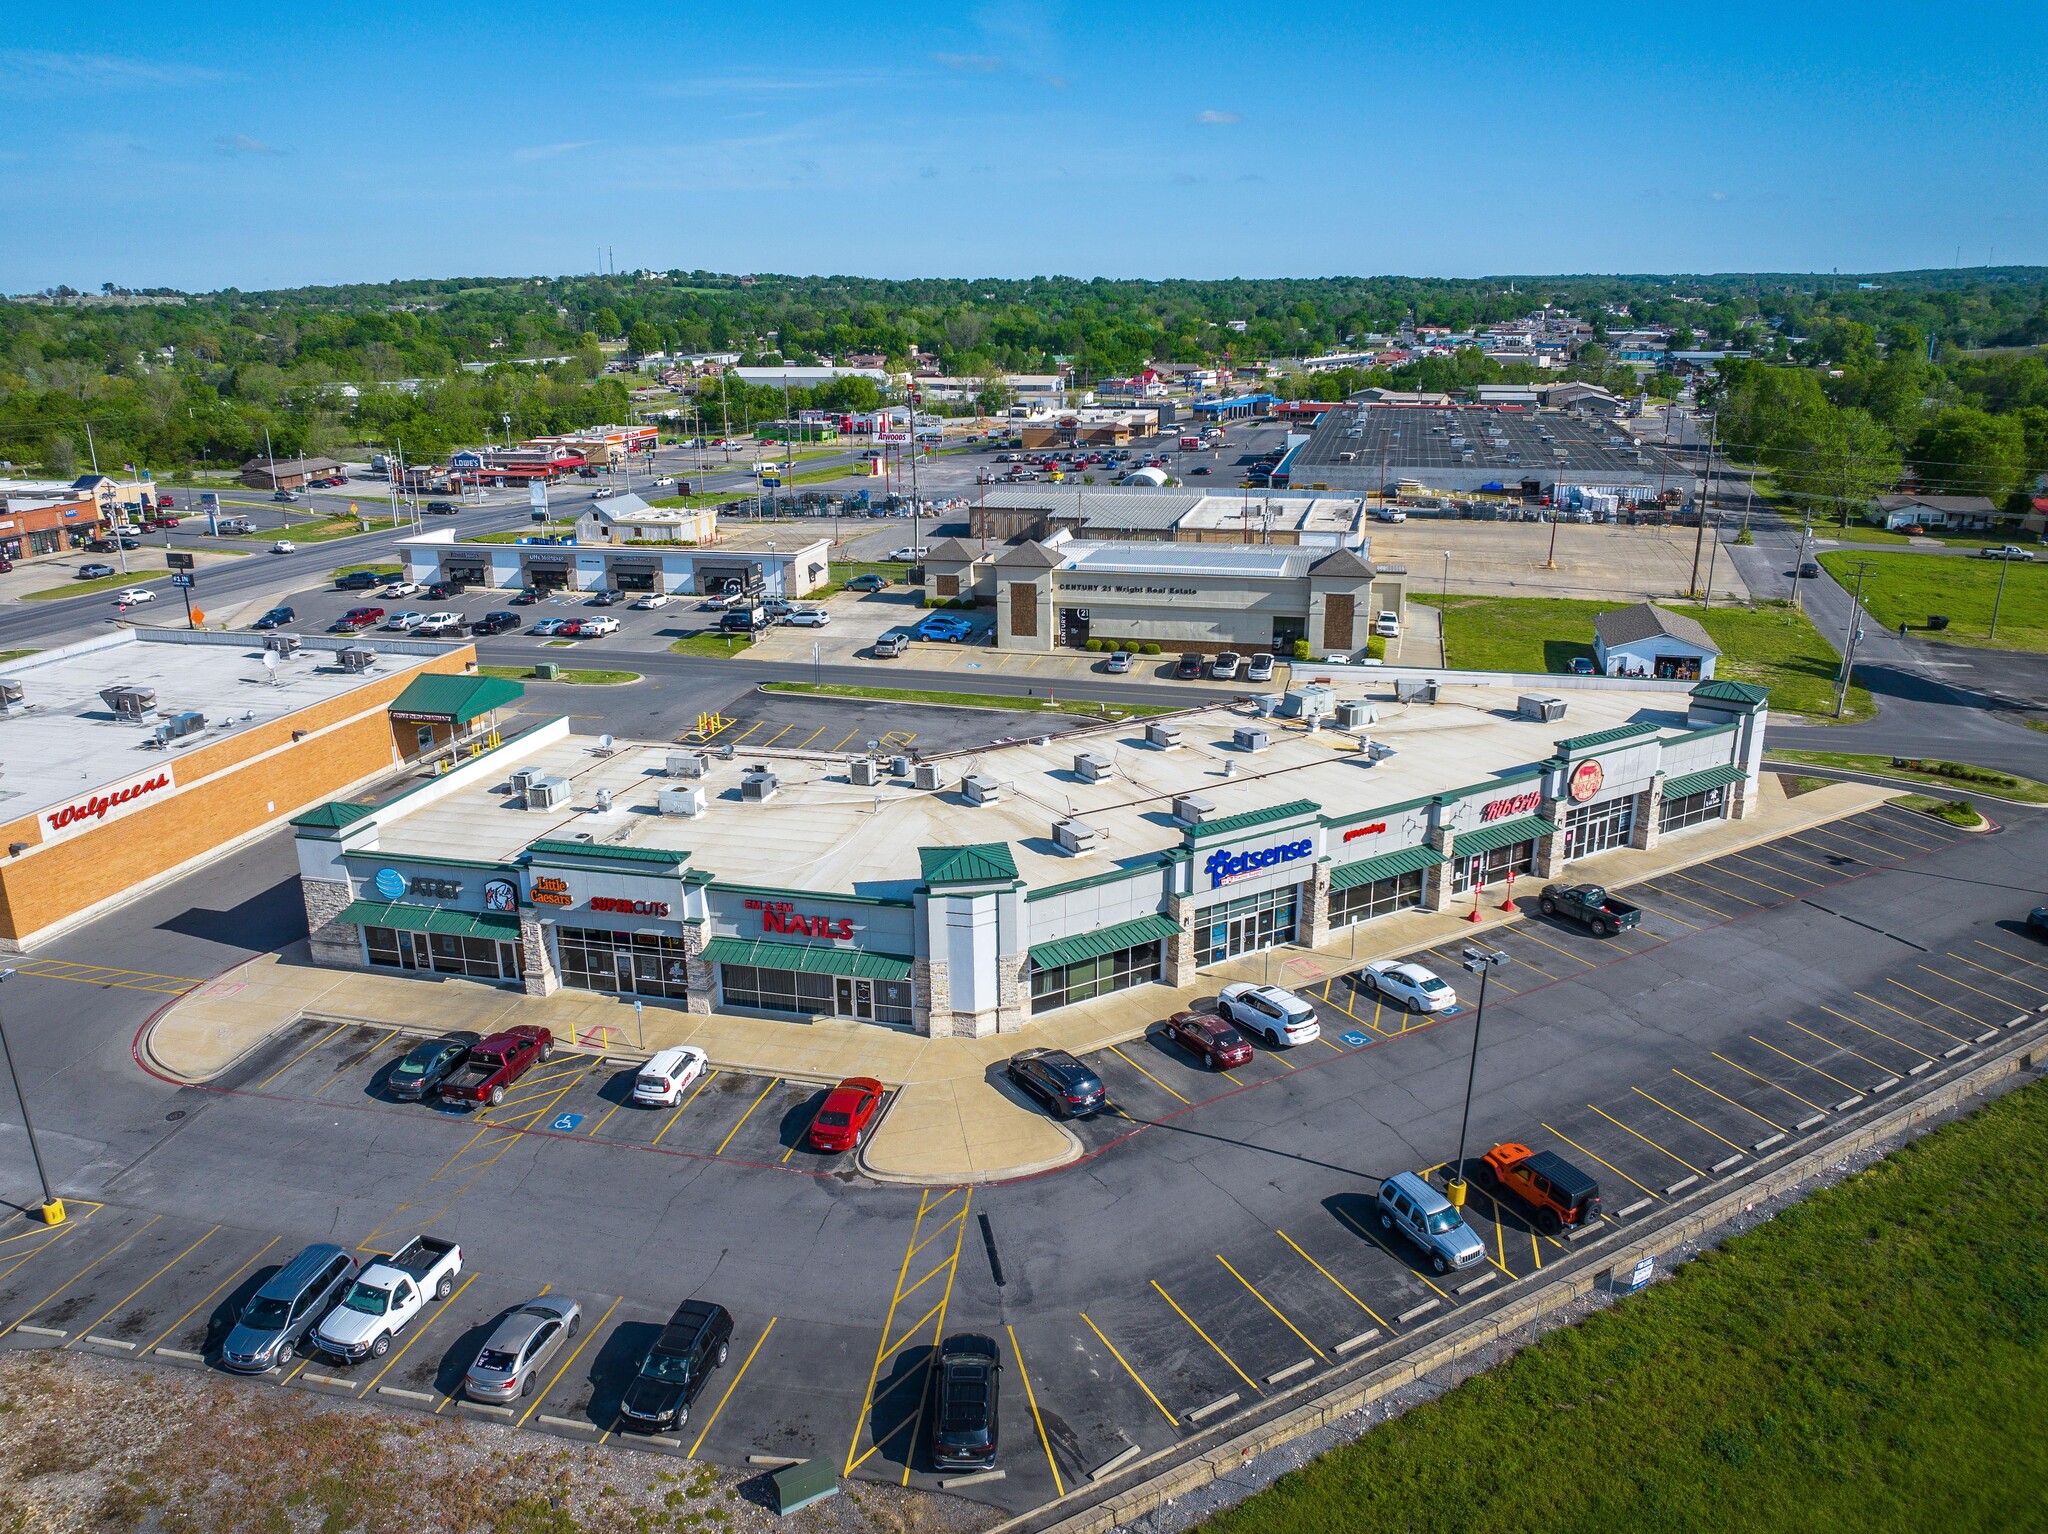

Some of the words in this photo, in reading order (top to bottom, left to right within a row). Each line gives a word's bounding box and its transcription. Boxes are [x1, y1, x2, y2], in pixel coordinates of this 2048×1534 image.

[454, 458, 479, 467] LOWE'S
[1115, 586, 1144, 594] Wright
[47, 773, 169, 830] Walgreens
[1485, 791, 1541, 822] RibCrib
[1211, 839, 1312, 889] petsense
[410, 877, 461, 899] AT&T
[536, 876, 567, 892] Little
[530, 889, 572, 906] Caesars
[590, 897, 669, 917] SUPERCUTS
[744, 900, 762, 910] EM
[764, 901, 774, 911] &
[763, 911, 854, 940] NAILS
